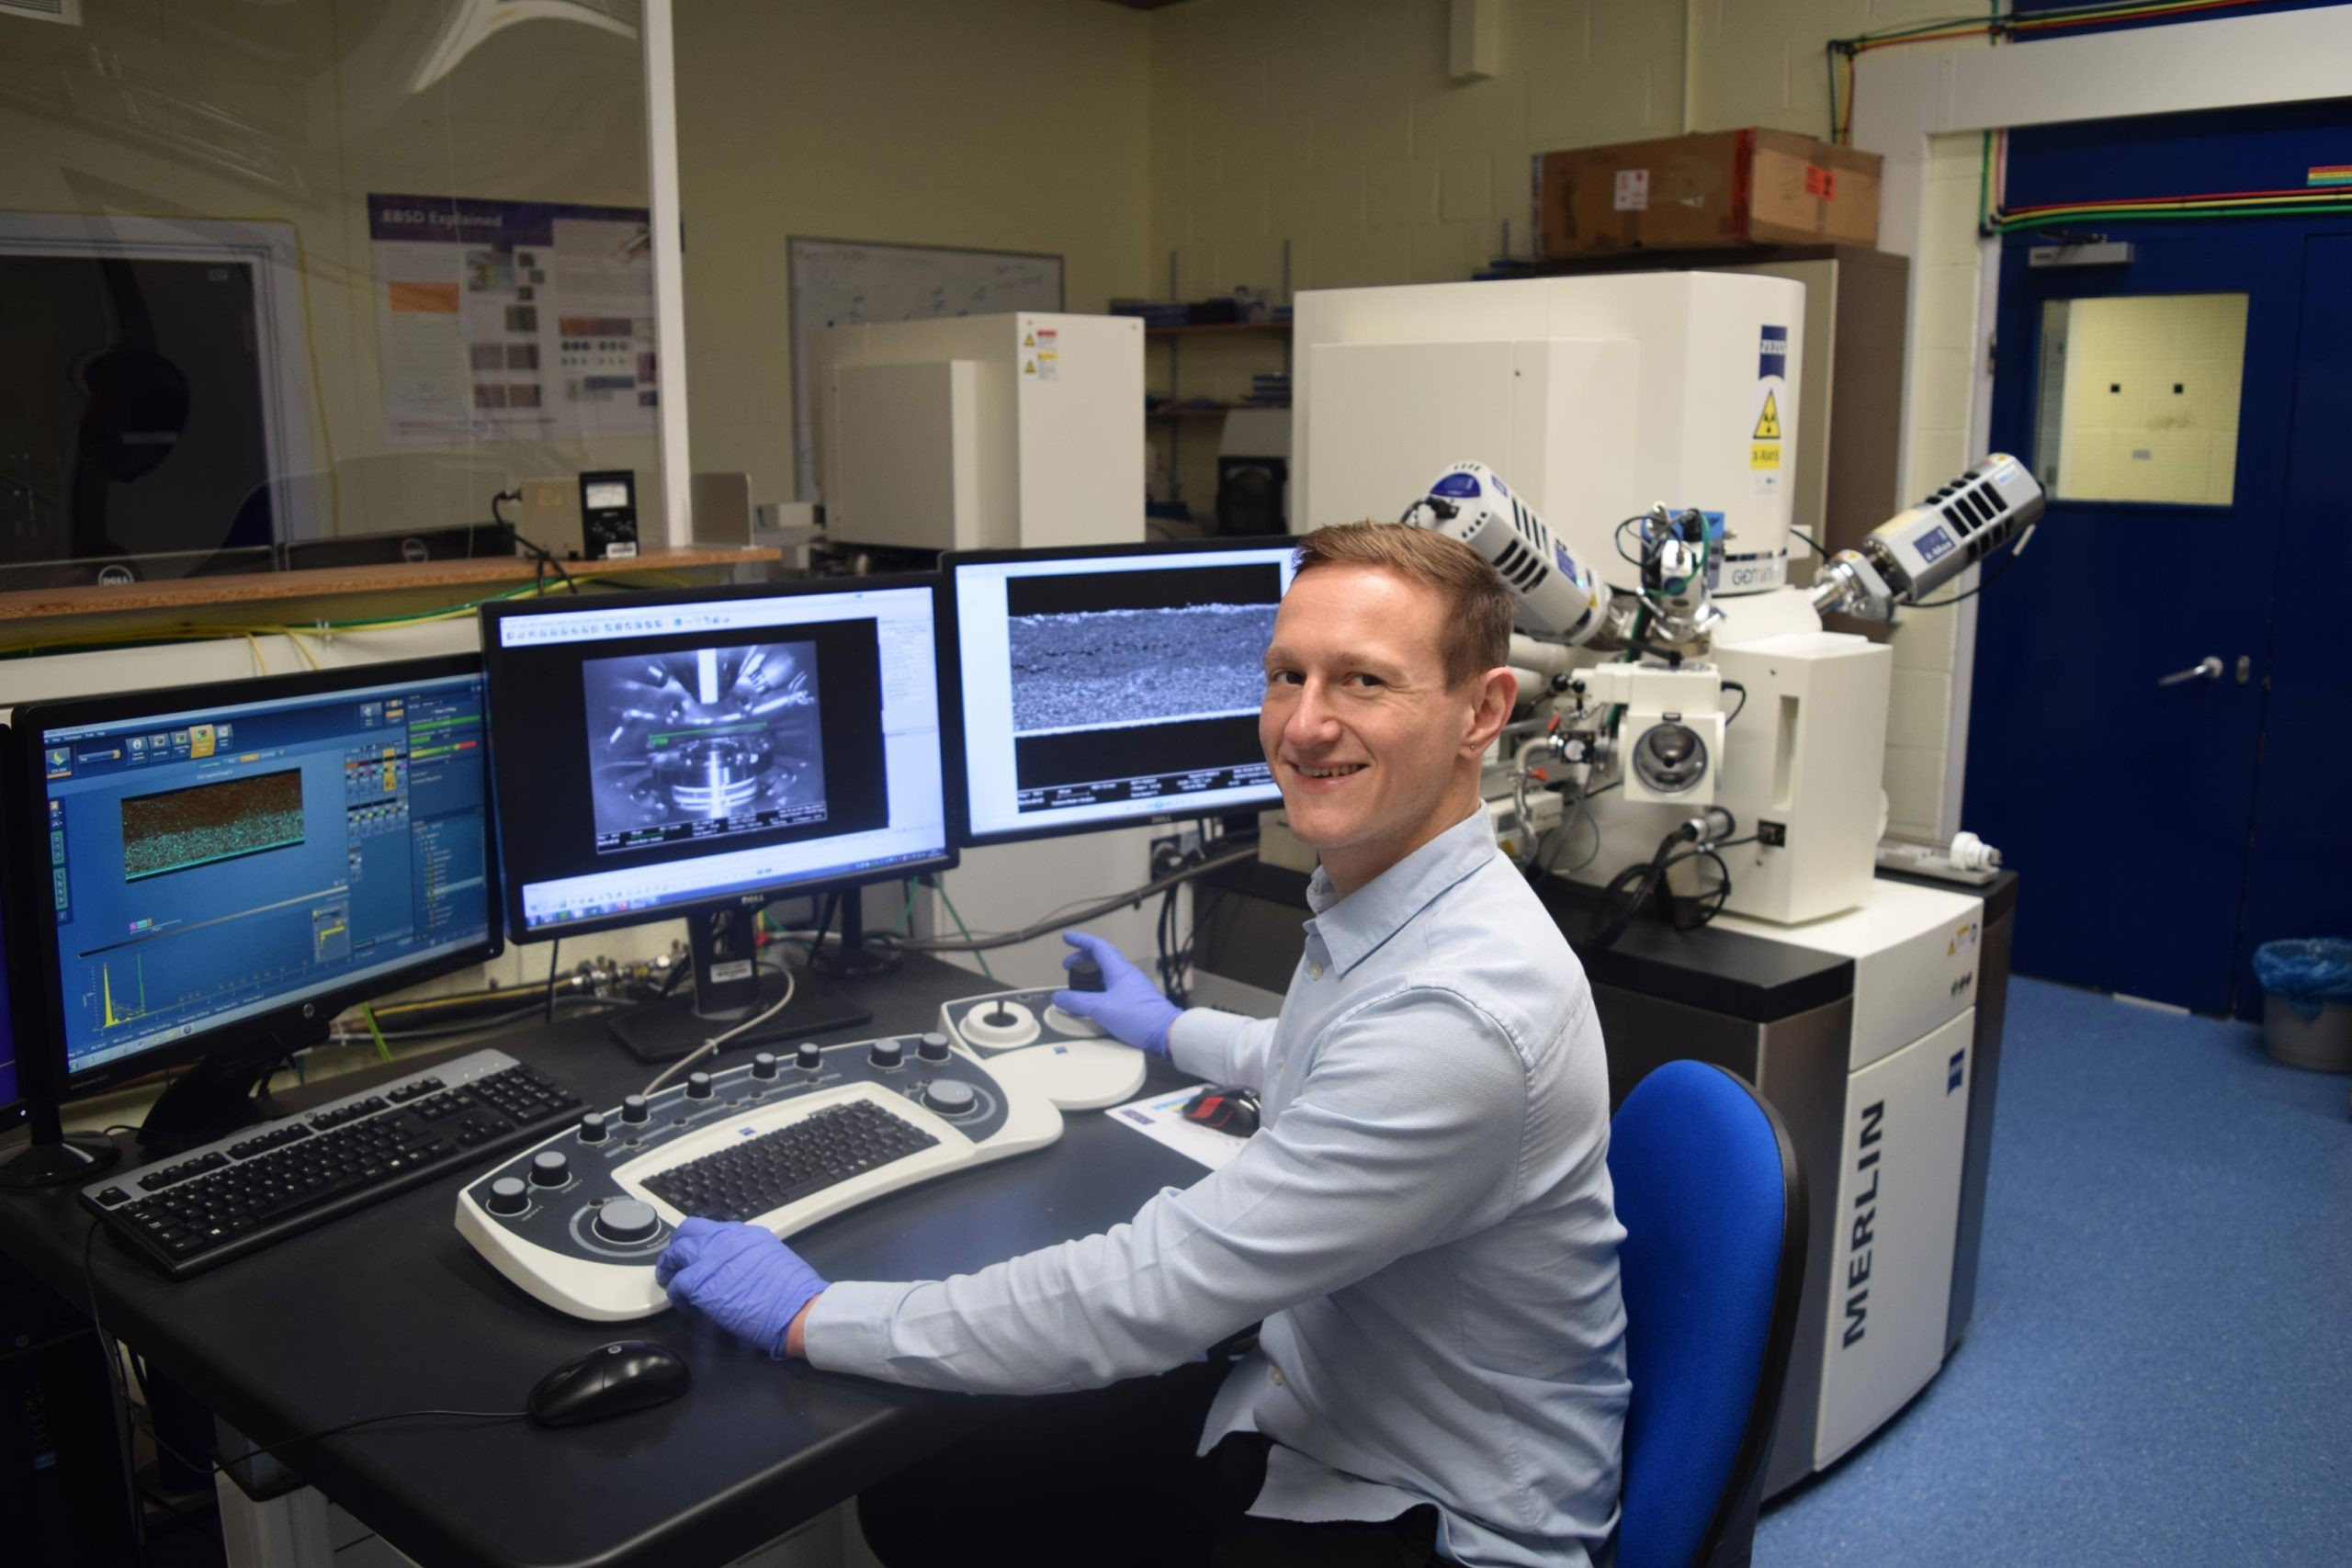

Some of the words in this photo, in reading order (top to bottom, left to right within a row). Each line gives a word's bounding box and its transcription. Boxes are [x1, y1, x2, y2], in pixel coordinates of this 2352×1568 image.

[382, 209, 425, 223] EBSD
[428, 210, 503, 230] Explained
[1841, 1100, 1885, 1350] MERLIN
